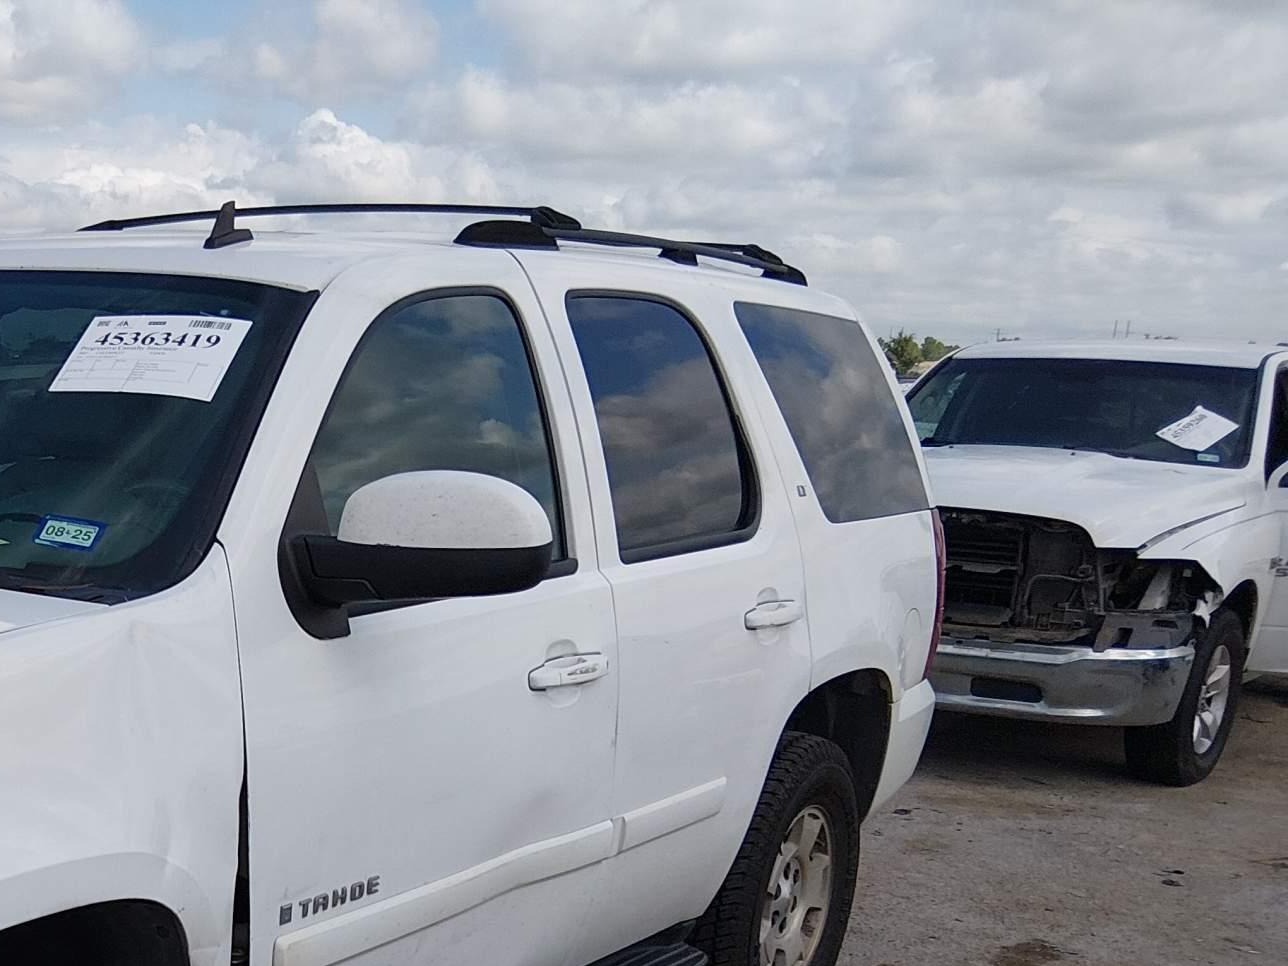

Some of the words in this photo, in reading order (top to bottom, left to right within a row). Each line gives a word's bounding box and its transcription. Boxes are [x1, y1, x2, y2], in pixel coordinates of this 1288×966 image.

[94, 332, 222, 349] 45363419
[46, 525, 66, 537] 08
[71, 529, 93, 541] 25
[298, 875, 381, 919] TAHOE
